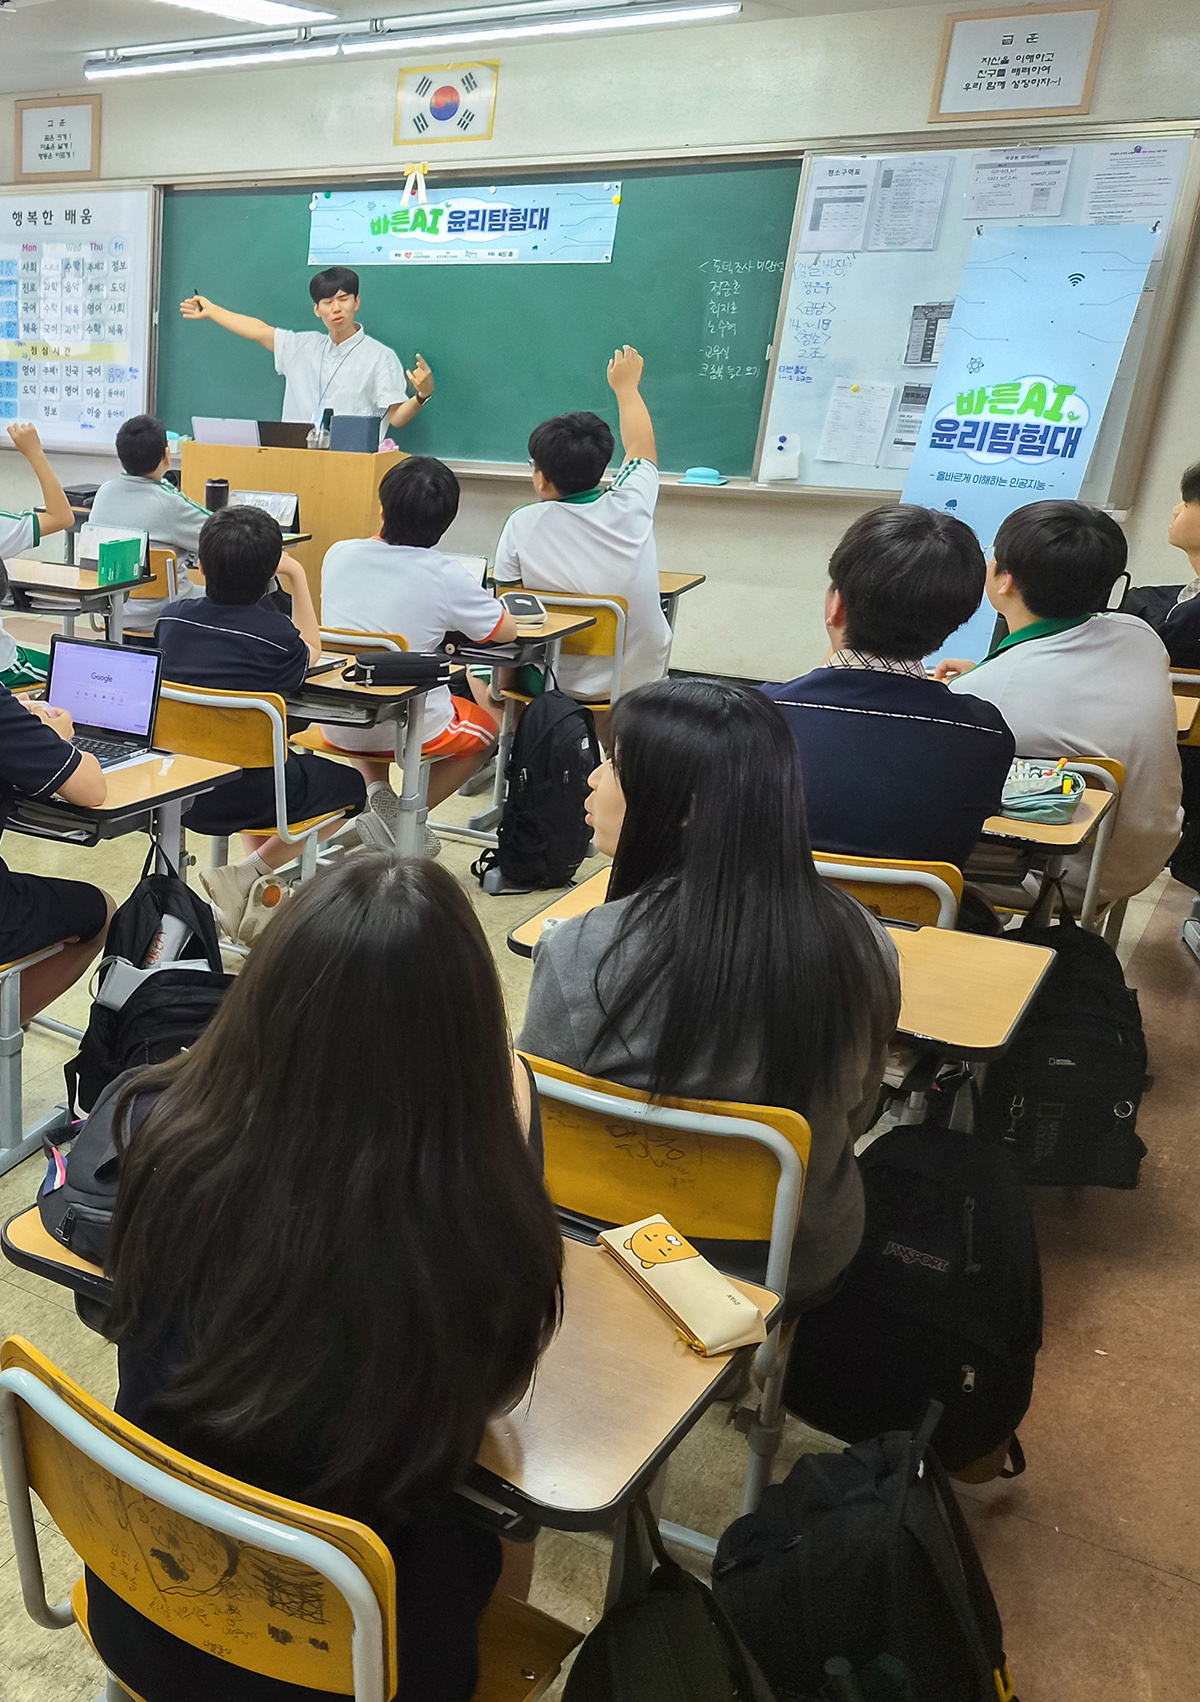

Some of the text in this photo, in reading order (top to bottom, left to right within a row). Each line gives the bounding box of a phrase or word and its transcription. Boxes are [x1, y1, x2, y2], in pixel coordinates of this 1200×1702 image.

[981, 52, 1054, 66] 자신을 이해하고
[977, 65, 1051, 79] 친구를 배려하여
[963, 82, 982, 92] 우리
[986, 81, 1006, 90] 함께
[827, 168, 861, 177] 청소구역표
[12, 208, 92, 226] 행복한 배움
[370, 207, 550, 236] 바른AI 윤리탐험대
[22, 244, 37, 252] Mon
[65, 242, 82, 252] Wed
[89, 242, 103, 251] Thu
[114, 241, 124, 251] Fri
[22, 261, 37, 272] 사회
[111, 260, 127, 272] 정보
[22, 282, 37, 294] 진로
[64, 281, 80, 293] 음악
[110, 282, 126, 293] 도덕
[22, 302, 37, 314] 국어
[87, 302, 102, 315] 영어
[109, 302, 125, 314] 사회
[22, 322, 38, 334] 체육
[43, 323, 58, 335] 국어
[86, 323, 101, 335] 수학
[22, 365, 36, 377] 영어
[86, 365, 101, 377] 국어
[22, 384, 37, 396] 도덕
[64, 385, 79, 397] 영어
[86, 387, 101, 399] 미술
[107, 388, 126, 399] 동아리
[956, 382, 1076, 422] 바른AI
[43, 405, 58, 417] 정보
[86, 406, 101, 419] 미술
[107, 409, 125, 419] 동아리
[929, 418, 1082, 459] 윤리탐험대
[936, 471, 970, 484] 올바르게
[972, 475, 1008, 487] 이해하는
[1009, 477, 1046, 490] 인공지능
[254, 499, 269, 507] 2026
[91, 672, 113, 684] Google
[882, 1241, 949, 1272] JANSPORT
